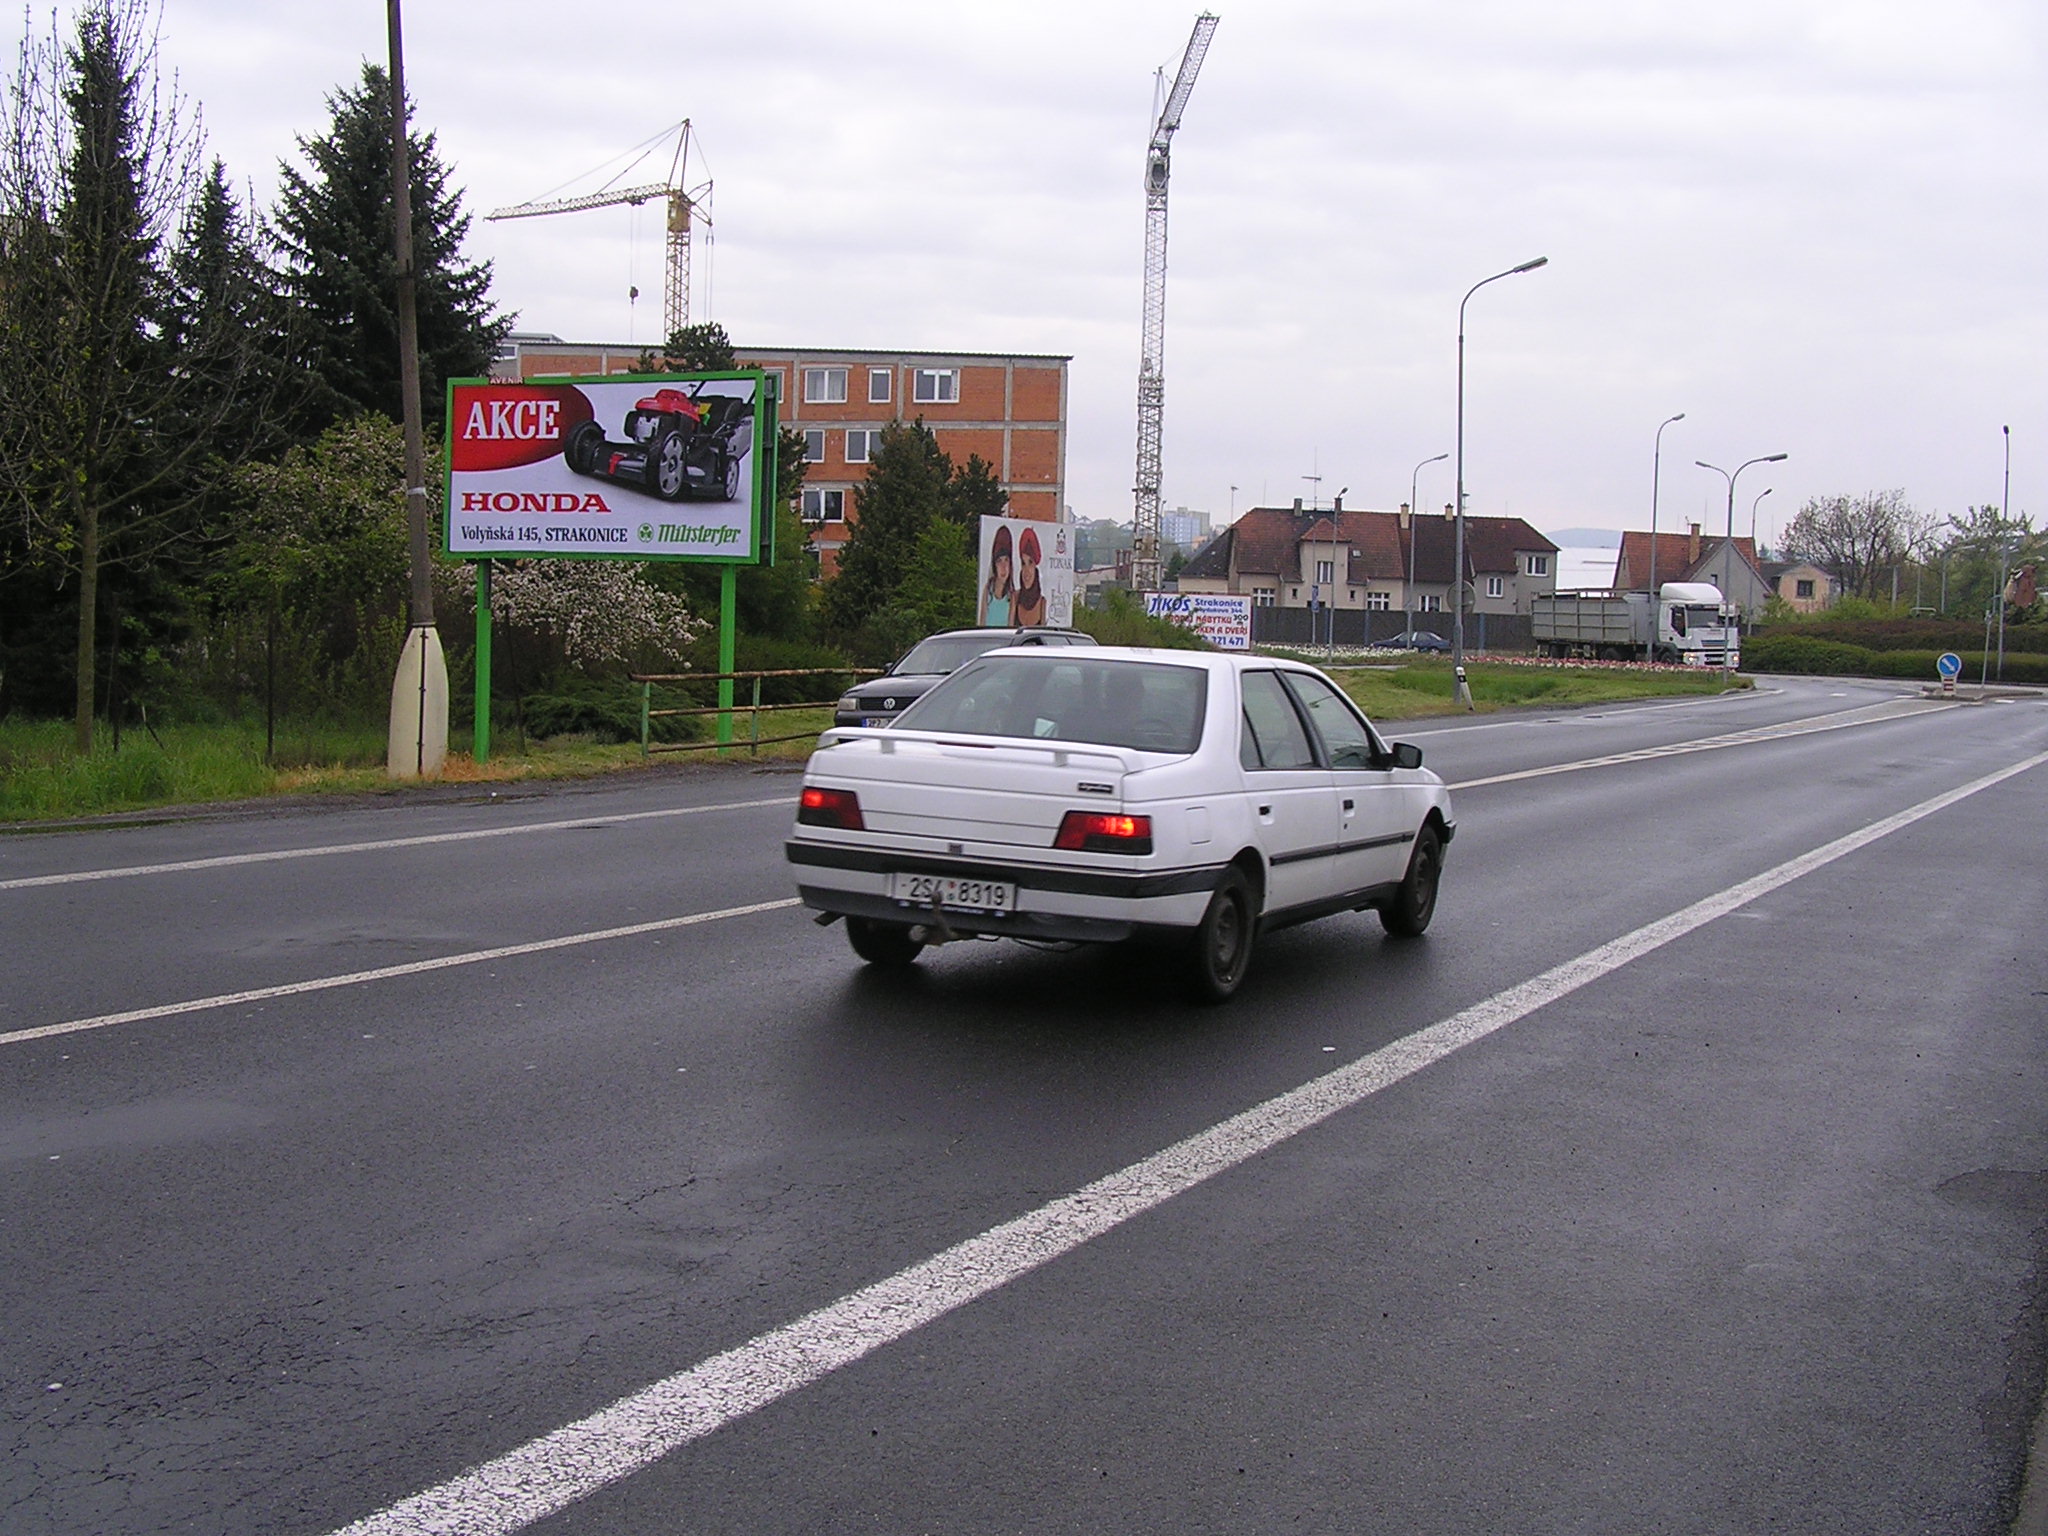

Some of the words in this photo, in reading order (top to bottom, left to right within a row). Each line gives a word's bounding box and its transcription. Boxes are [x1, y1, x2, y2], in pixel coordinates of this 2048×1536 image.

[490, 376, 523, 385] AVENIR
[462, 400, 561, 440] AKCE
[461, 492, 612, 513] HONDA
[461, 525, 514, 544] Volyňská
[518, 526, 541, 543] 145,
[545, 527, 628, 543] STRAKONICE
[1149, 597, 1192, 613] JIKOS
[1195, 598, 1243, 607] Strakonice
[1229, 636, 1244, 646] 471
[959, 882, 1005, 906] 8319
